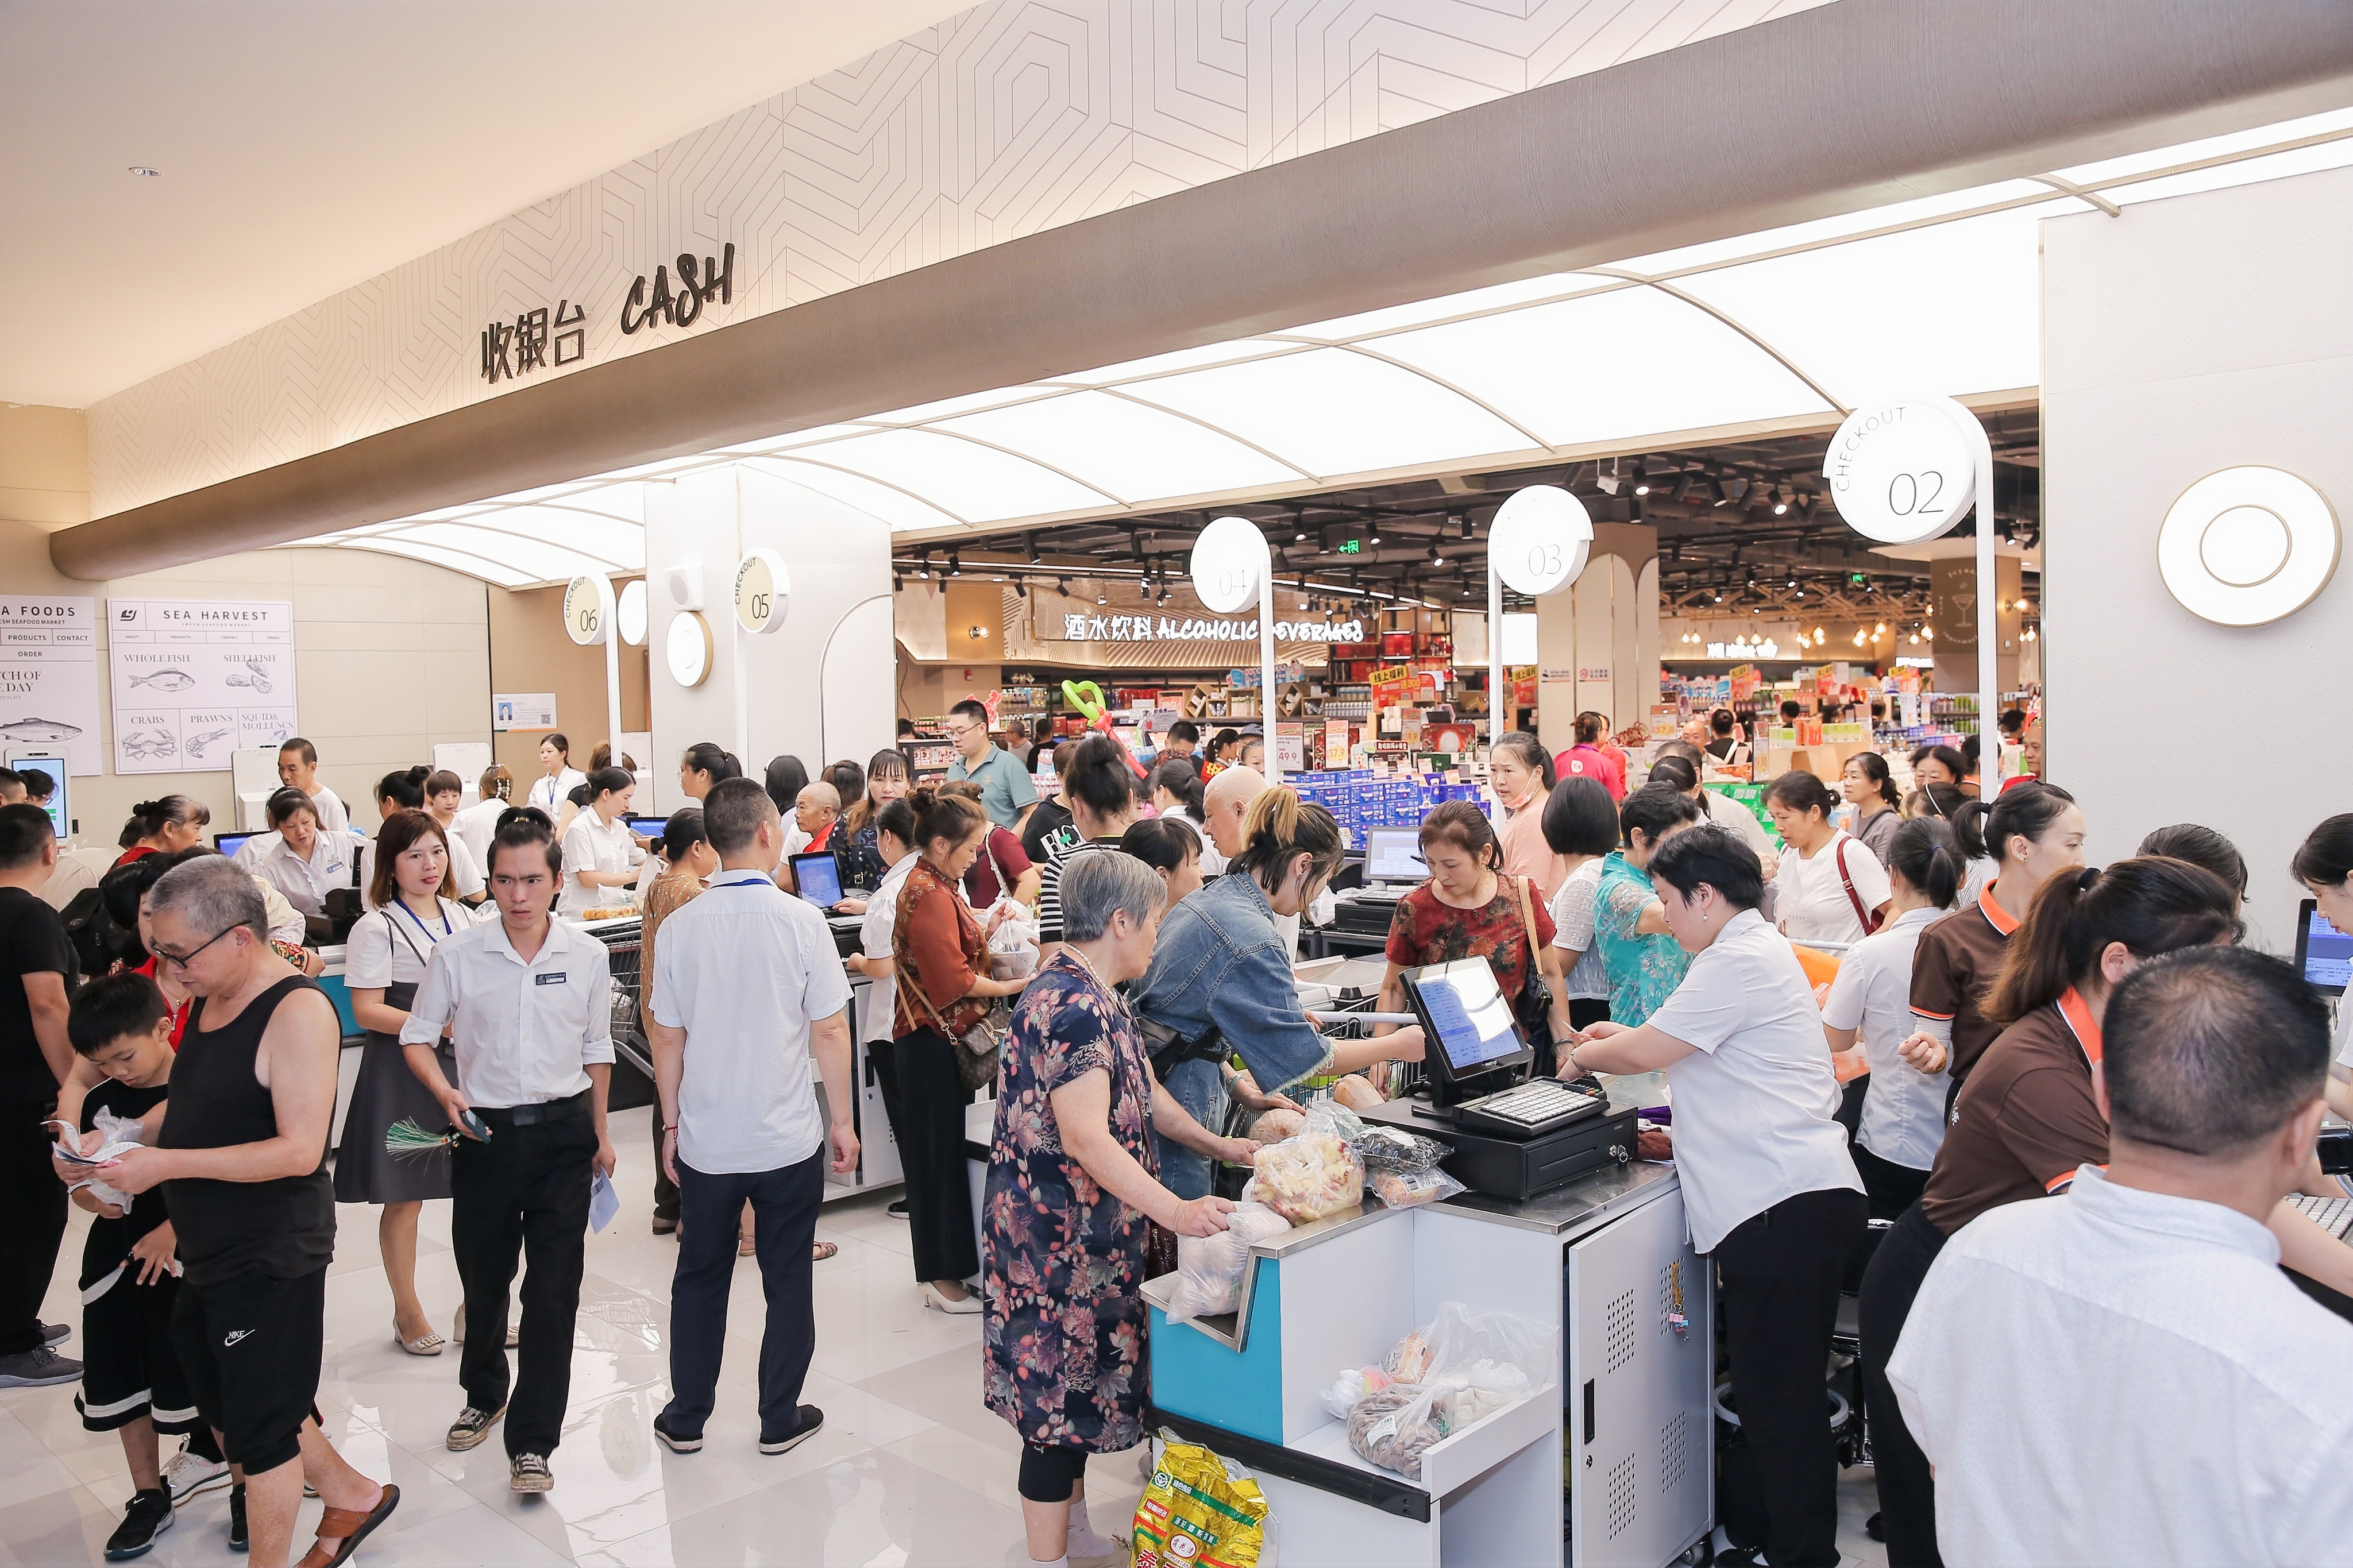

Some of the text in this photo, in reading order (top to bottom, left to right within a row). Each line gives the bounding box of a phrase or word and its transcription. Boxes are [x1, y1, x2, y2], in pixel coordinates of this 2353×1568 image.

[621, 242, 735, 335] CASH
[481, 299, 586, 384] 收银台
[1836, 407, 1906, 491] CHECKOUT
[1889, 470, 1944, 516] 02
[1529, 544, 1561, 576] 03
[735, 557, 756, 605] CHECKOUT
[1220, 570, 1247, 596] 04
[566, 576, 586, 619] CHECKOUT
[21, 606, 75, 616] FOODS
[751, 594, 769, 619] 05
[163, 610, 268, 621] SEA HARVEST
[580, 609, 597, 632] 06
[1063, 613, 1365, 643] 酒水饮料 ALCOHOLIC EVERAGES
[223, 654, 276, 662] SHELLFISH
[24, 671, 42, 681] OF
[6, 682, 34, 692] DAY
[131, 716, 165, 725] CRABS
[190, 715, 233, 723] PRAWNS
[241, 713, 279, 721] SQUID&
[242, 722, 294, 731] MOLLUSCS
[1278, 752, 1297, 762] 49.9
[1329, 748, 1345, 758] 57.9
[228, 1330, 245, 1339] NIKE
